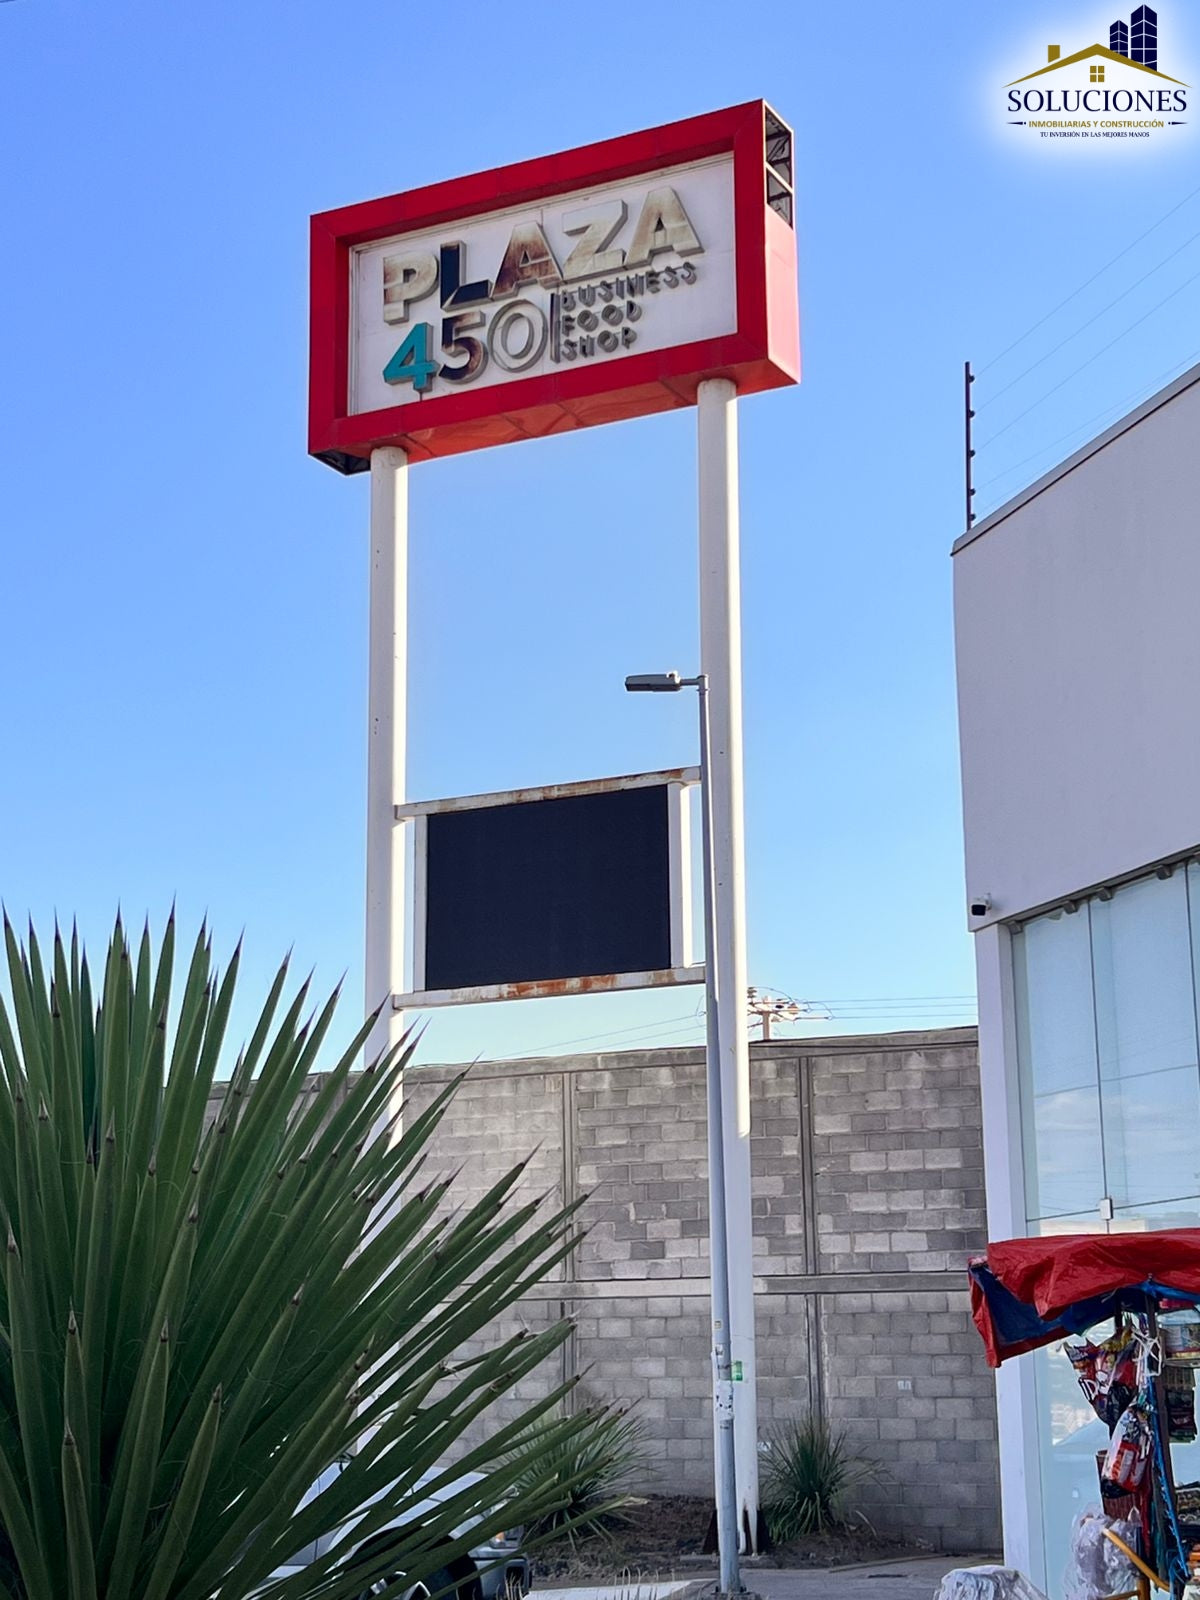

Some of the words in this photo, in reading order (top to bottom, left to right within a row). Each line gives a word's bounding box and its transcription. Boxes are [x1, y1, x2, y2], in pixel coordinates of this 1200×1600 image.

[382, 185, 705, 325] PLAZA
[561, 261, 698, 313] BUSINESS
[561, 299, 643, 337] FOOD
[561, 326, 638, 362] SHOP
[382, 298, 549, 393] 450
